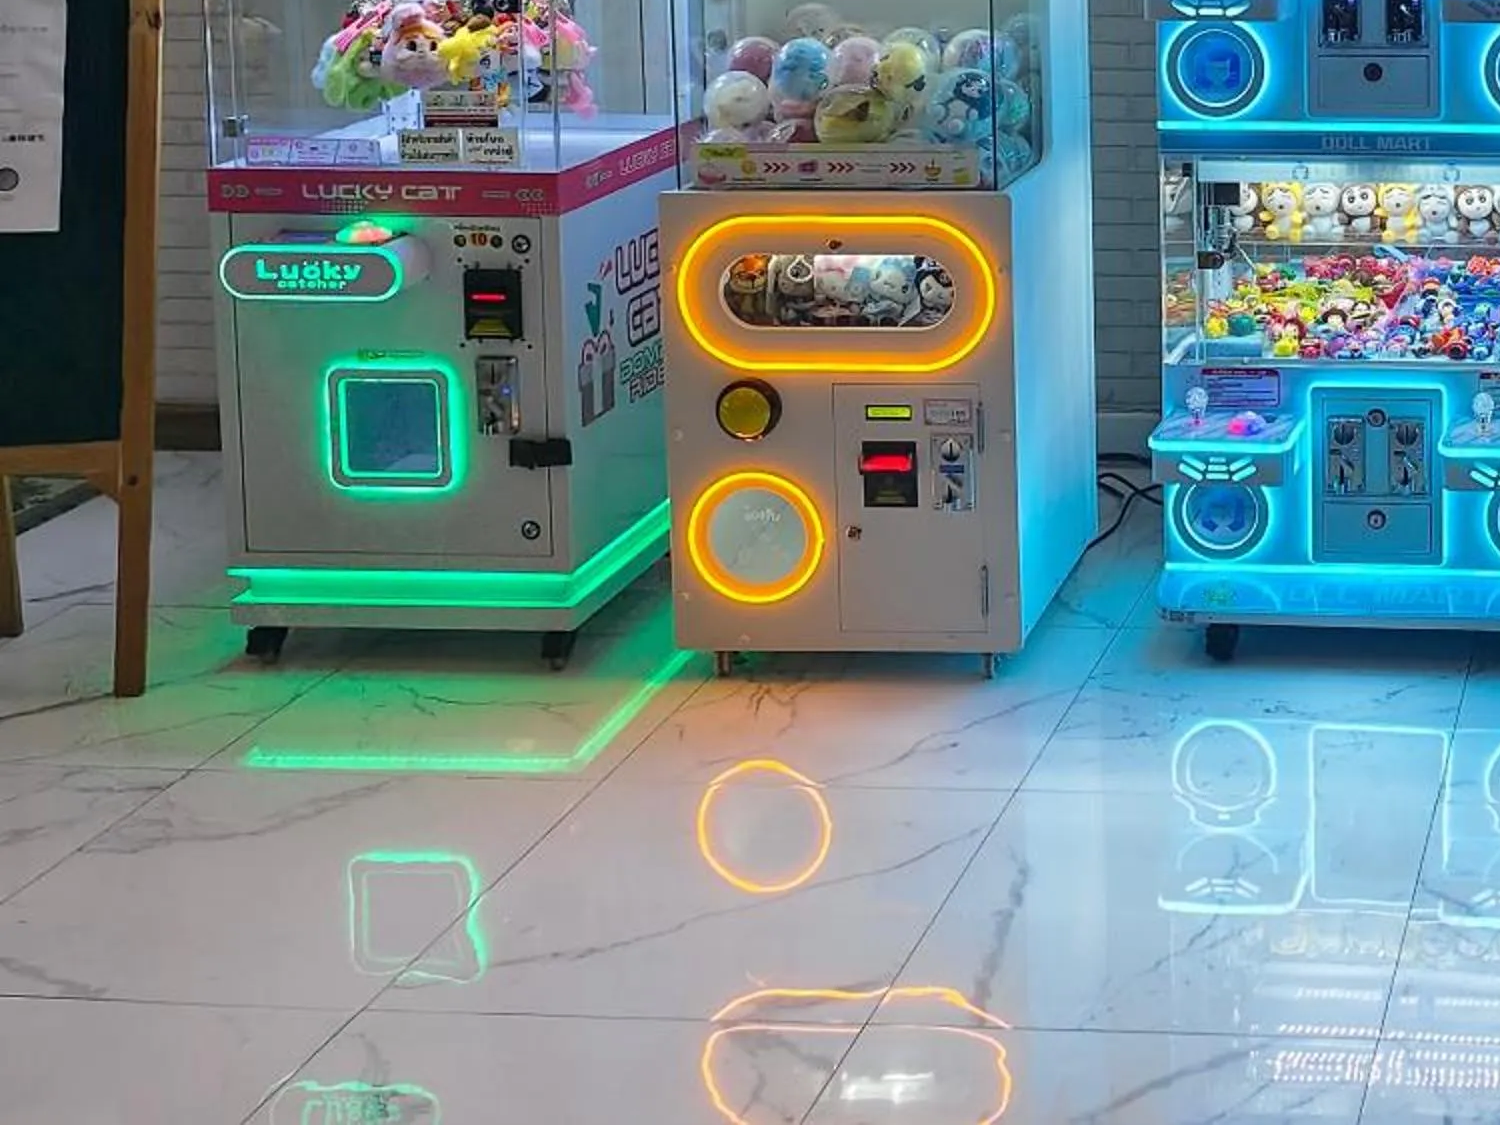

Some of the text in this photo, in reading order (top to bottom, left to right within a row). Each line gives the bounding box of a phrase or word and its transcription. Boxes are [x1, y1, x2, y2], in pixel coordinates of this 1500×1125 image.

[1376, 136, 1430, 151] MART
[302, 184, 393, 200] LUCKY
[470, 232, 487, 246] 10
[255, 259, 361, 280] Lucky
[277, 278, 346, 290] catcher
